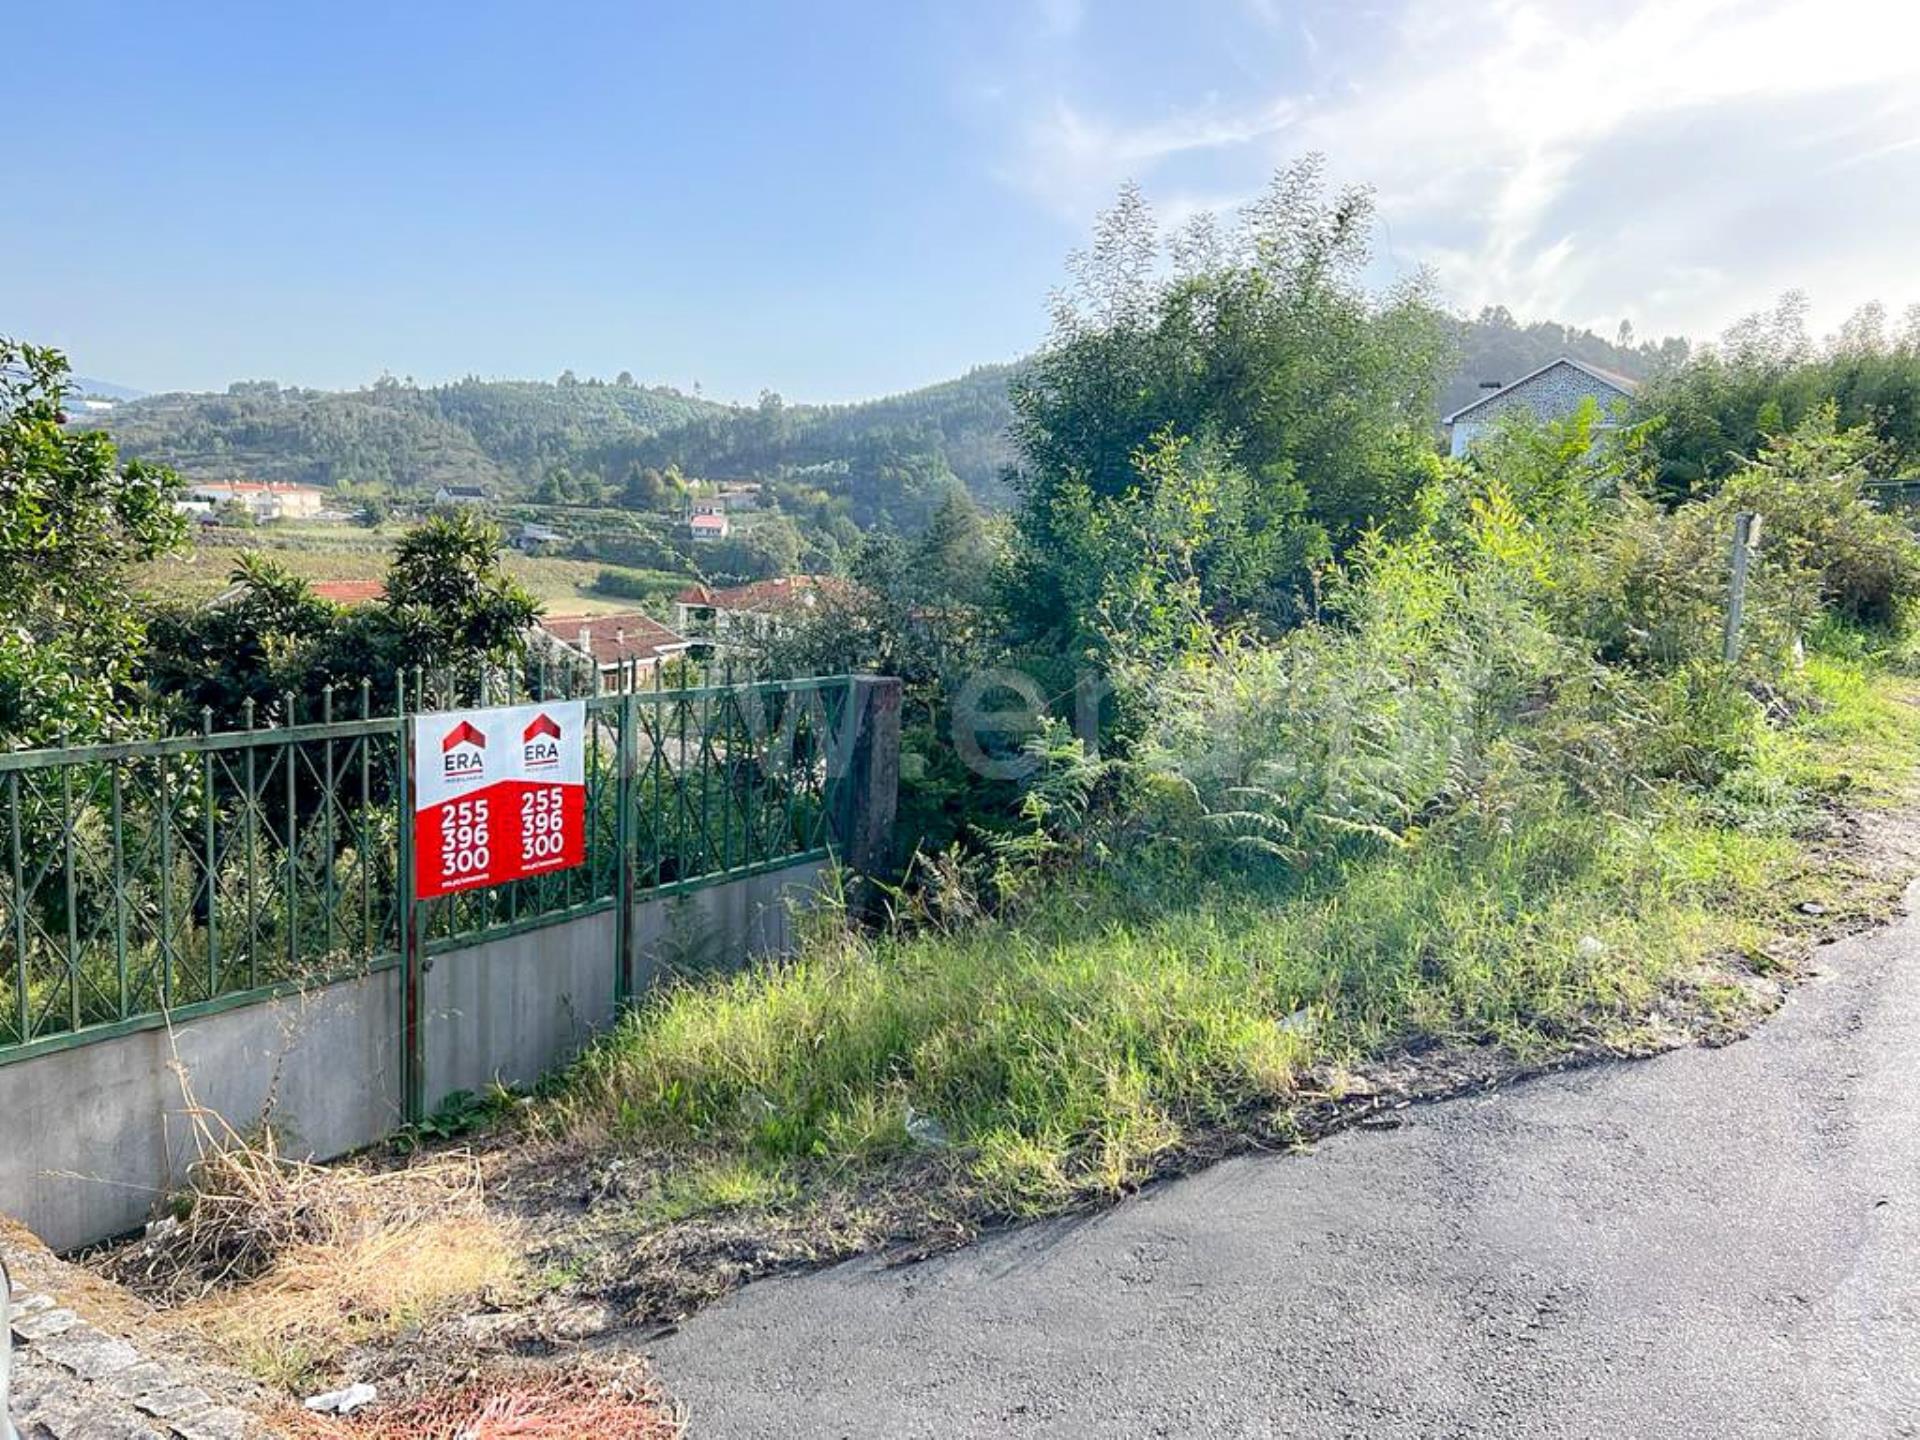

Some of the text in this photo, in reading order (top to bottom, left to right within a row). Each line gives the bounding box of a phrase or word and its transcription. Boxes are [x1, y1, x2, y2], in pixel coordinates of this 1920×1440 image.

[445, 752, 483, 770] ERA
[525, 742, 559, 761] ERA
[442, 799, 489, 829] 255
[521, 788, 563, 815] 255
[522, 809, 563, 836] 396
[442, 822, 489, 852] 396
[522, 832, 563, 859] 300
[442, 847, 490, 876] 300
